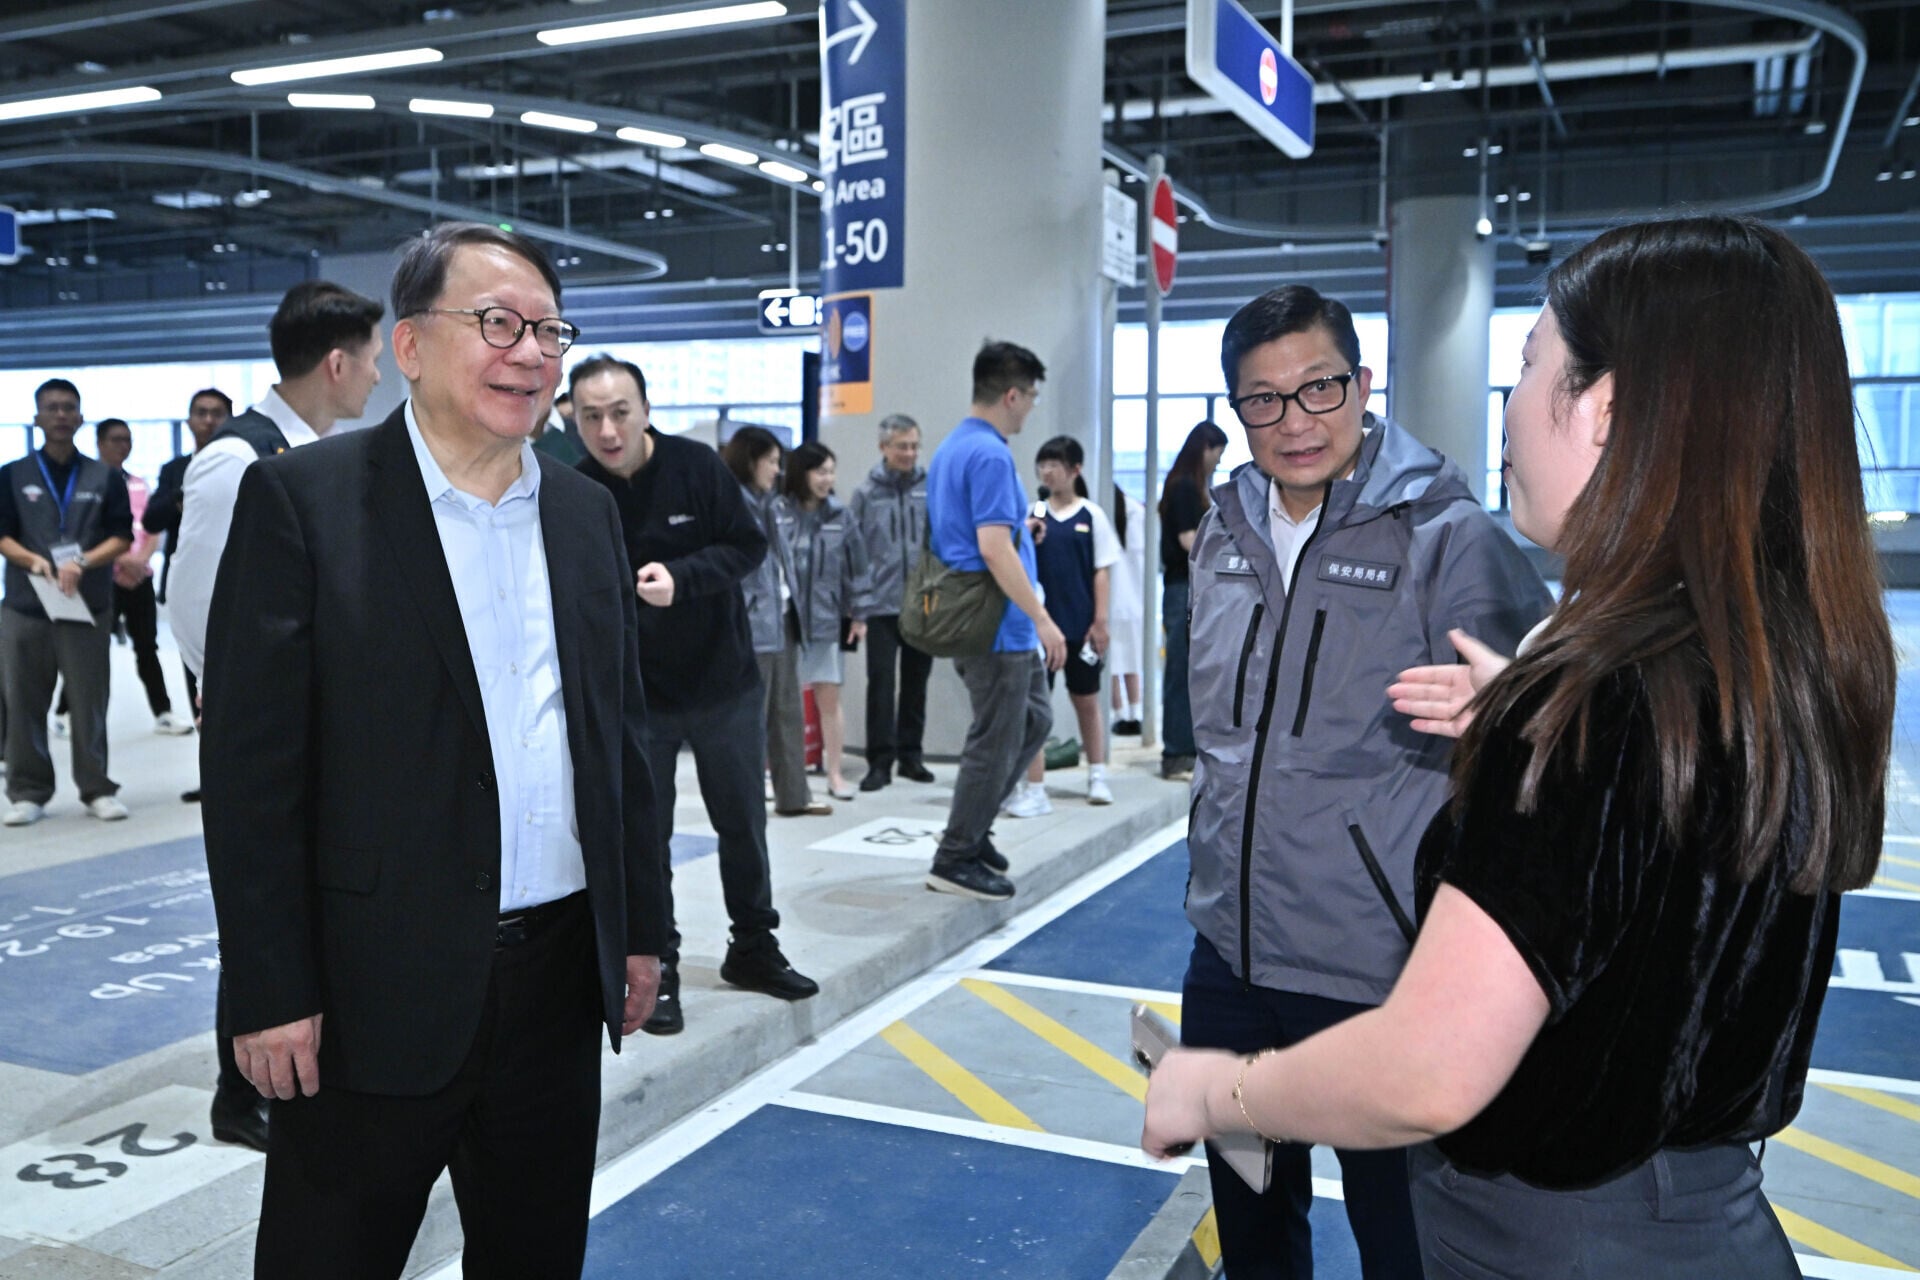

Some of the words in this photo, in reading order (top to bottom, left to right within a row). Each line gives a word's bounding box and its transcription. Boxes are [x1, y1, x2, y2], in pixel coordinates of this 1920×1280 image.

[836, 177, 886, 204] Area
[1328, 562, 1387, 582] 保安局局長
[0, 915, 150, 964] 19-2
[89, 972, 195, 1000] Up
[16, 1122, 198, 1190] 28
